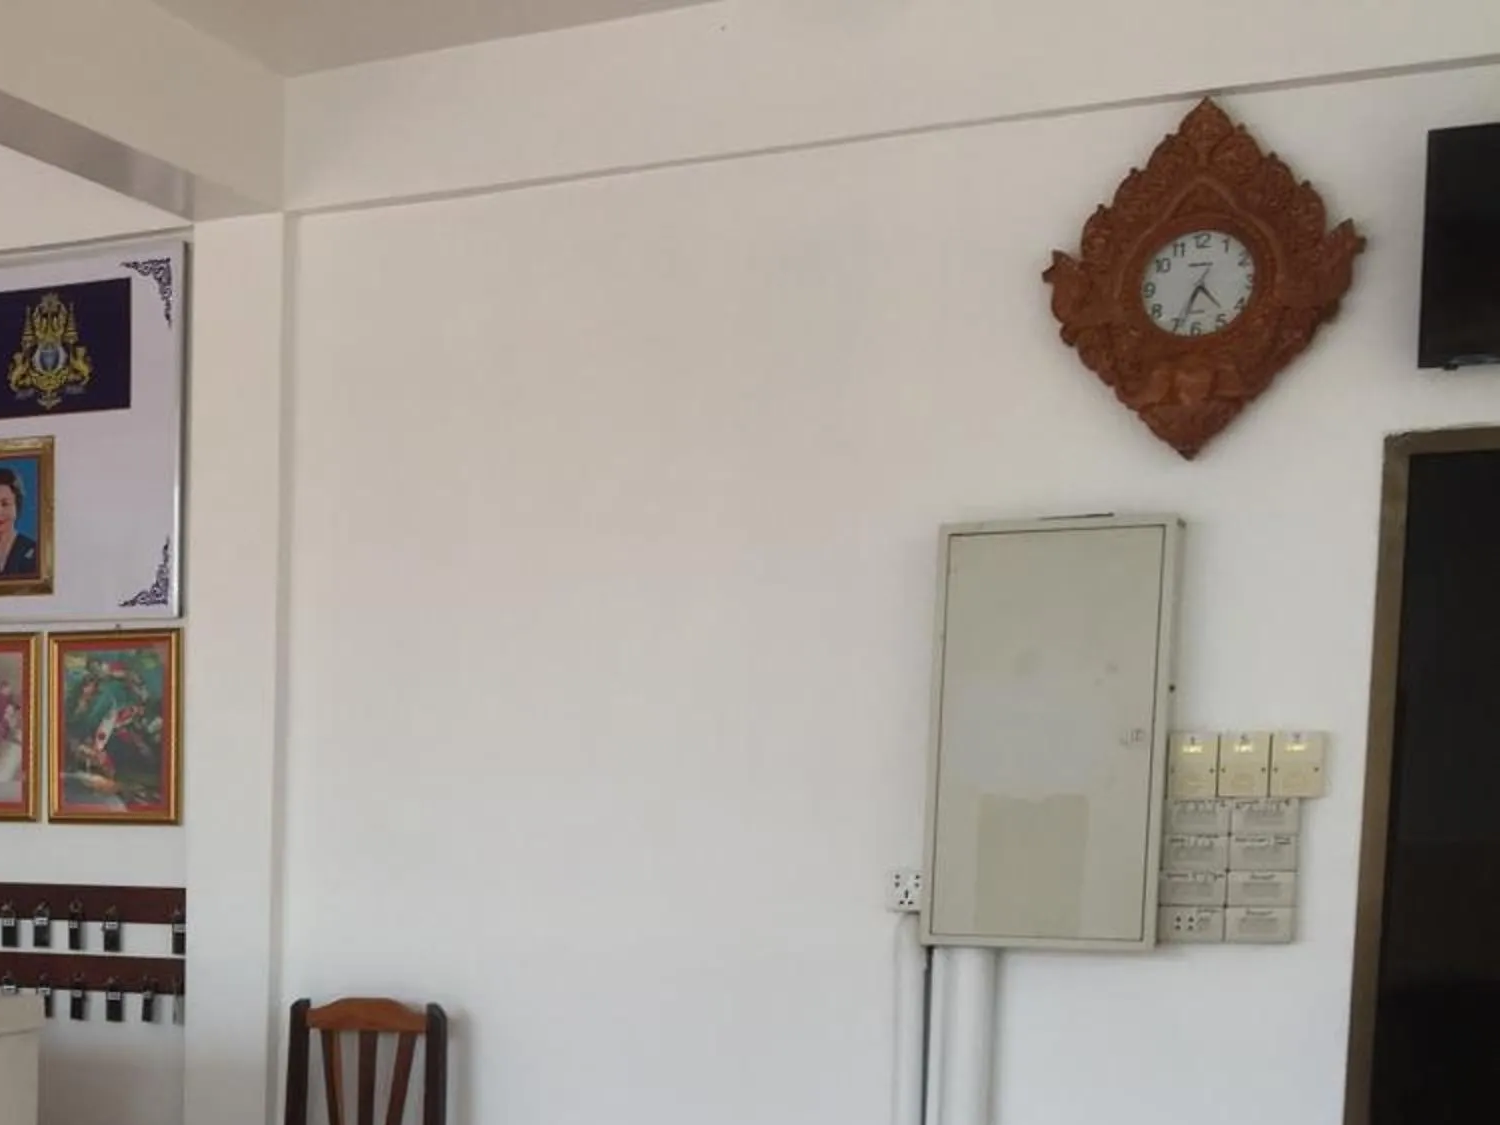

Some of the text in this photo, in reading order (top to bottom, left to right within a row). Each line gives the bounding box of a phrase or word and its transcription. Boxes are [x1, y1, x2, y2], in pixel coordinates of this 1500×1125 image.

[1193, 233, 1212, 248] 12
[1173, 242, 1186, 258] 11
[1155, 257, 1171, 273] 10
[1238, 252, 1249, 267] 2
[1144, 281, 1156, 298] 9
[1152, 303, 1162, 318] 8
[1234, 296, 1246, 311] 4
[1216, 313, 1226, 327] 5
[1190, 321, 1202, 336] 6
